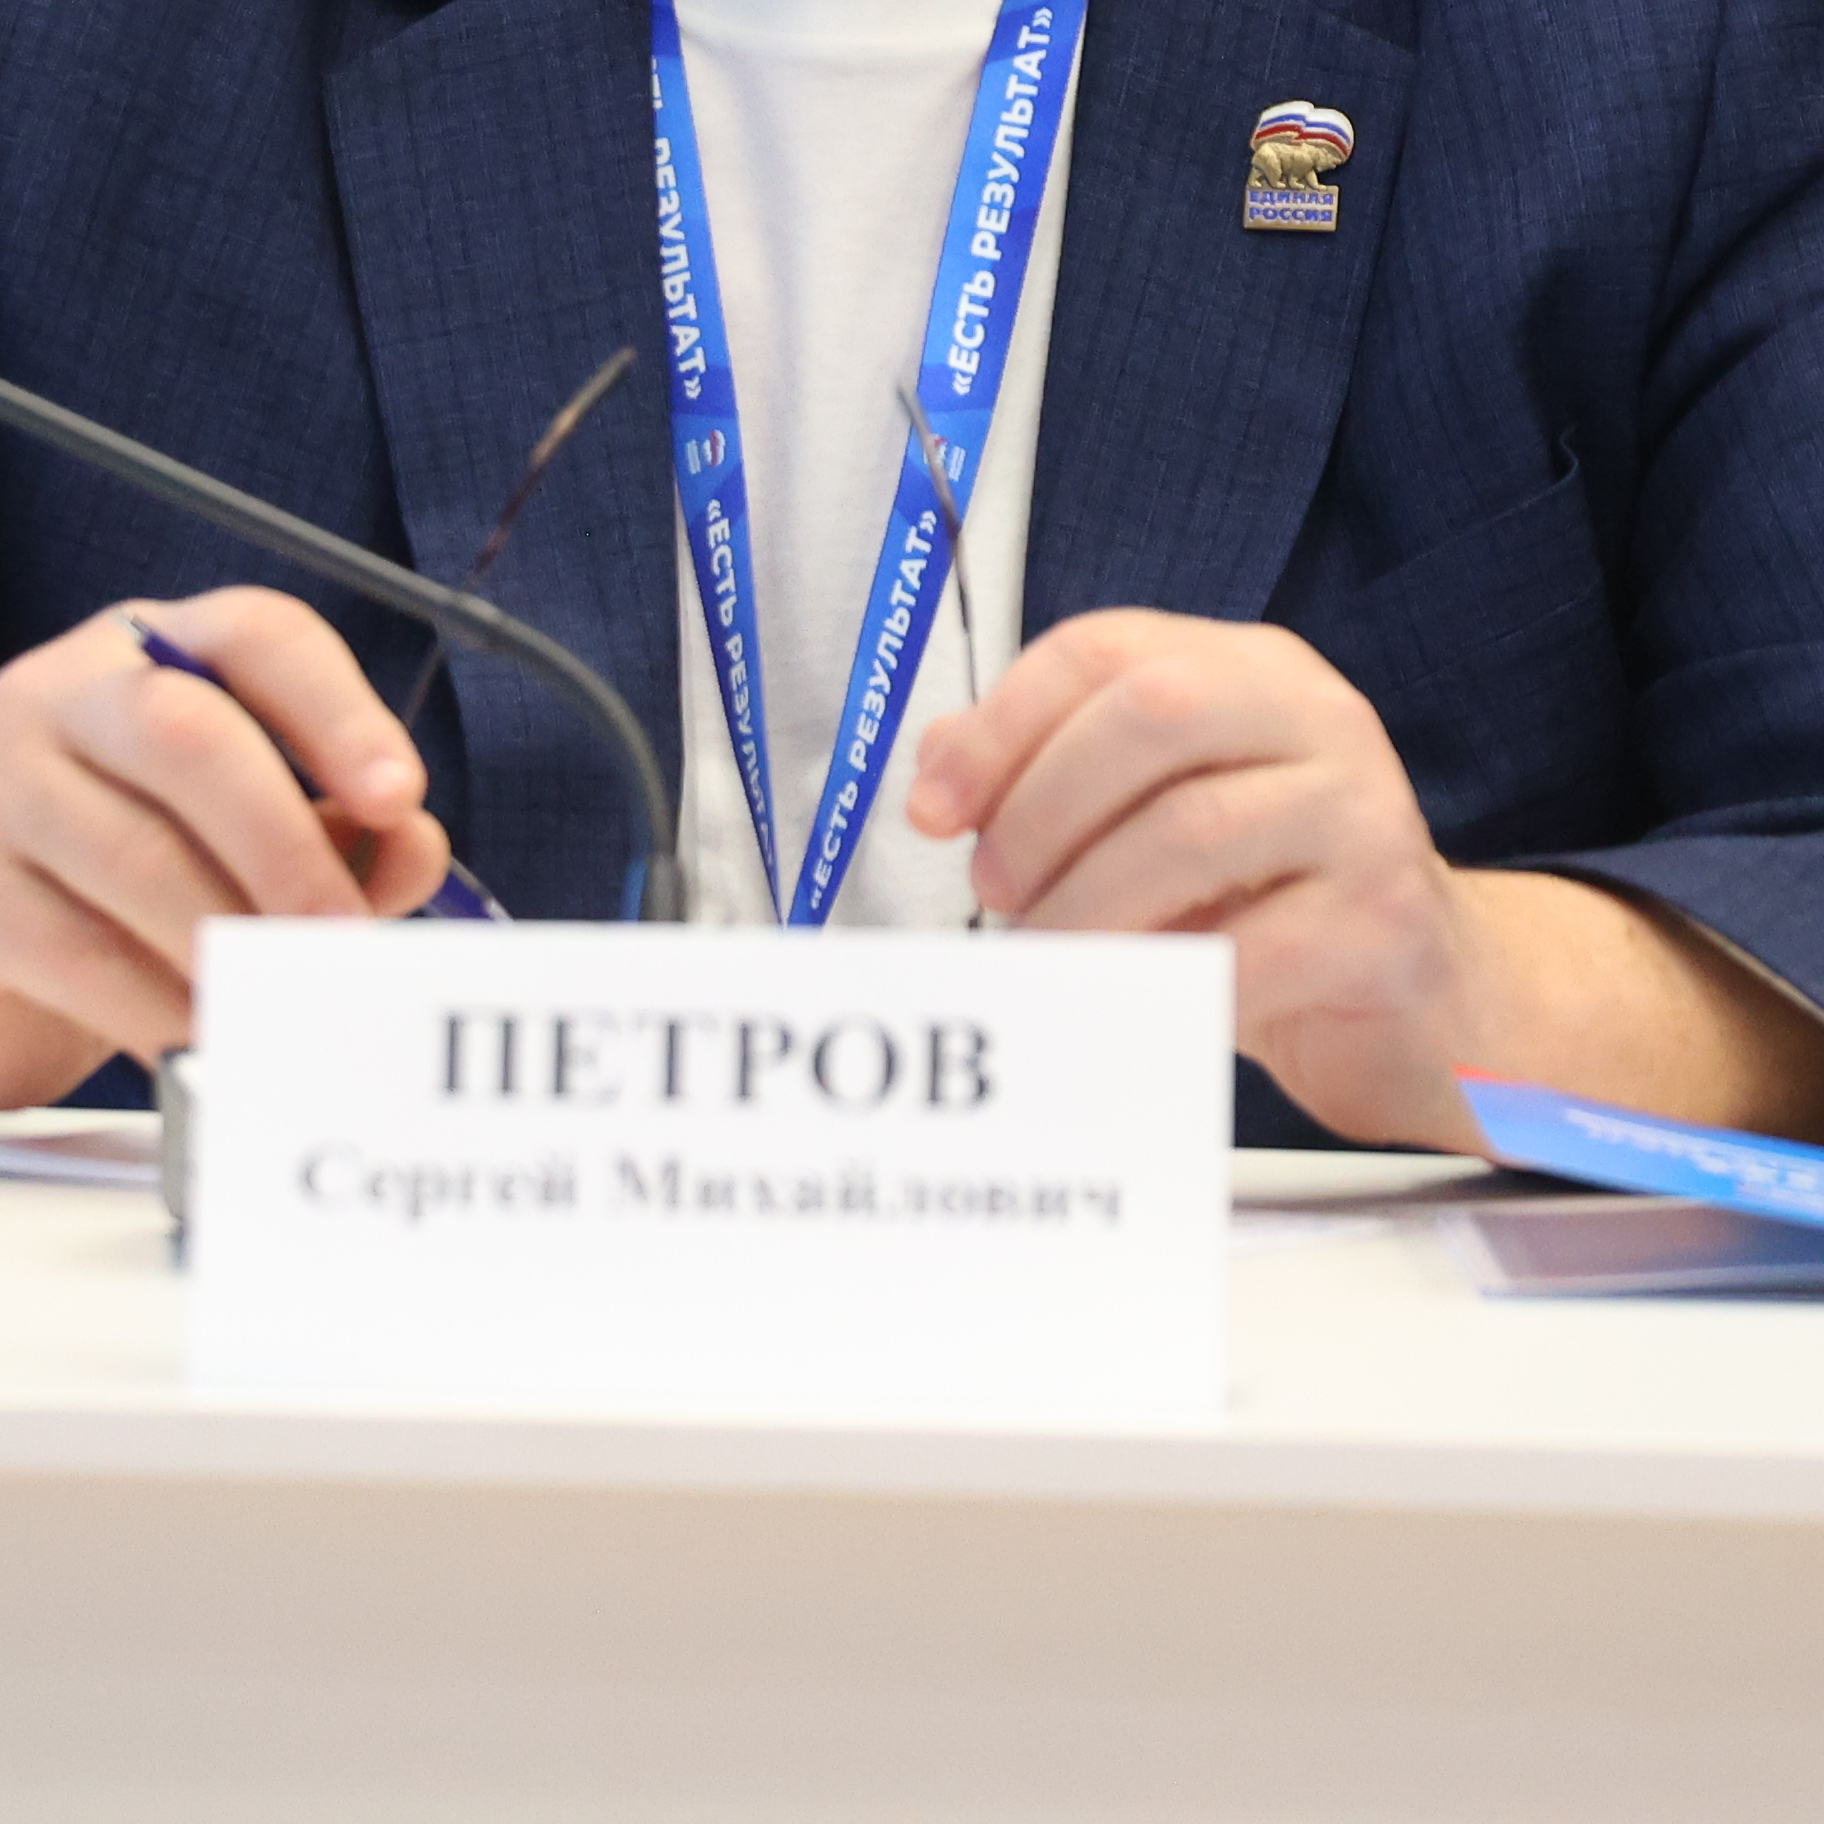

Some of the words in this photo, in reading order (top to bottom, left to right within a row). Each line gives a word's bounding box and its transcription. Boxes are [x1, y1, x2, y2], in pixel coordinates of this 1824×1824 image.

[970, 5, 1054, 261] РЕЗУЛЬТАТ»
[1249, 207, 1333, 222] РОССИЯ
[1250, 190, 1334, 205] ЕДИНАЯ
[947, 270, 997, 397] «ЕСТЬ
[706, 499, 738, 627] «ЕСТЬ
[810, 779, 860, 910] «ЕСТЬ
[849, 509, 937, 772] РЕЗУЛЬТАТ»
[438, 1008, 996, 1112] ПЕТРОВ
[297, 1147, 578, 1225] Сергей
[614, 1151, 1121, 1223] Михайлович
